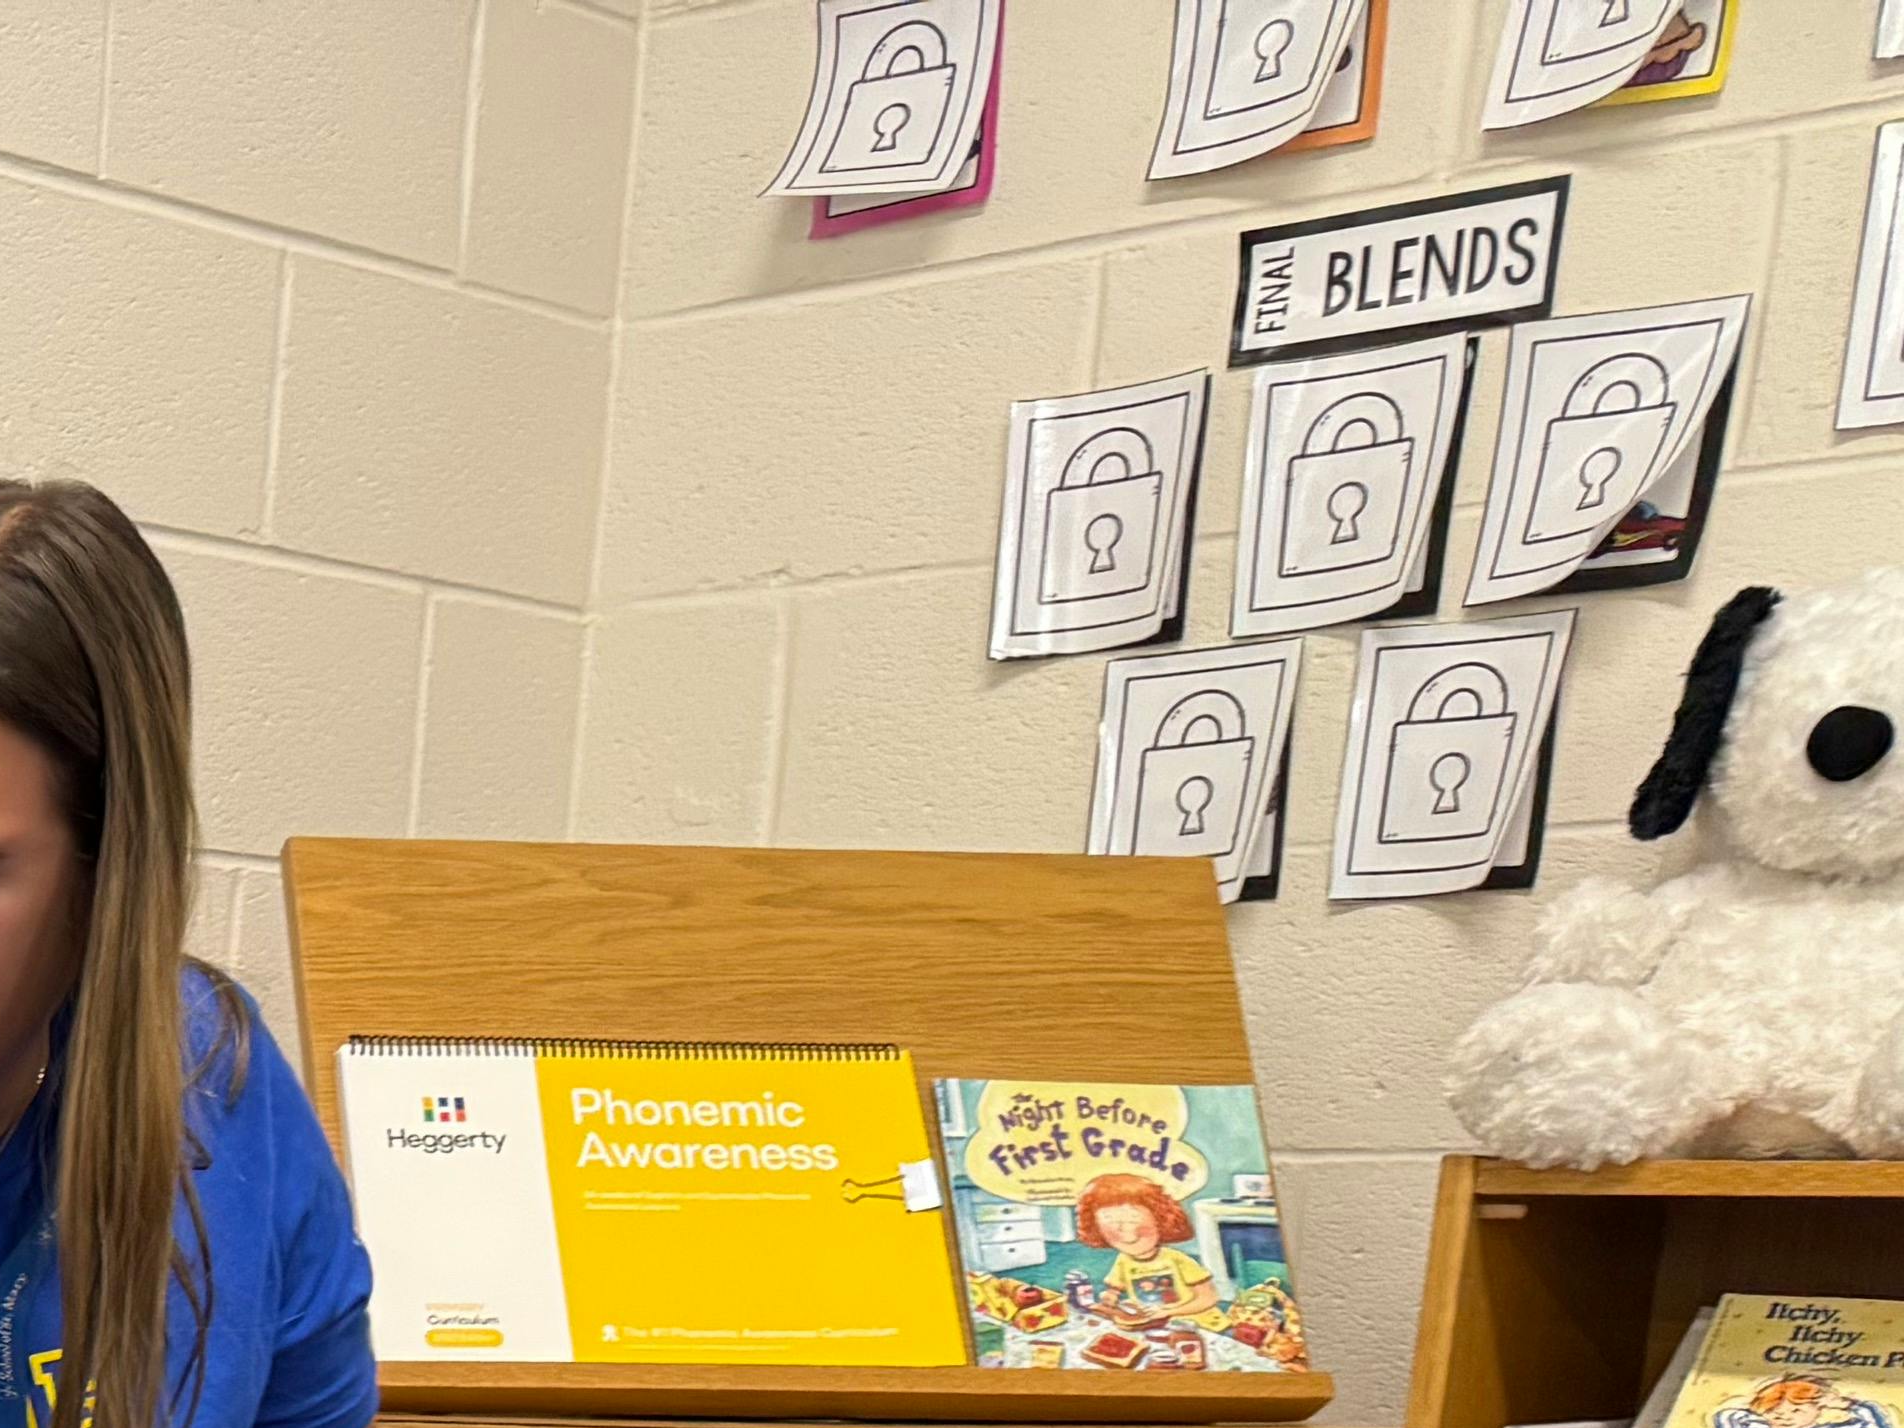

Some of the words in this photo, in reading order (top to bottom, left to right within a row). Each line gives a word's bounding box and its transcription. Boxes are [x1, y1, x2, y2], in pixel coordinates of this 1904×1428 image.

[1322, 217, 1540, 319] BLENDS
[1253, 244, 1296, 335] FINAL
[570, 1086, 806, 1129] Phonemic
[998, 1100, 1065, 1133] Night
[1076, 1096, 1169, 1135] Before
[385, 1128, 507, 1154] Heggerty
[577, 1132, 840, 1171] Awareness
[989, 1123, 1072, 1176] First
[1080, 1127, 1190, 1182] Grade
[1766, 1302, 1841, 1325] Itchy,
[1789, 1325, 1864, 1347] Itchy
[1764, 1345, 1880, 1367] Chicken
